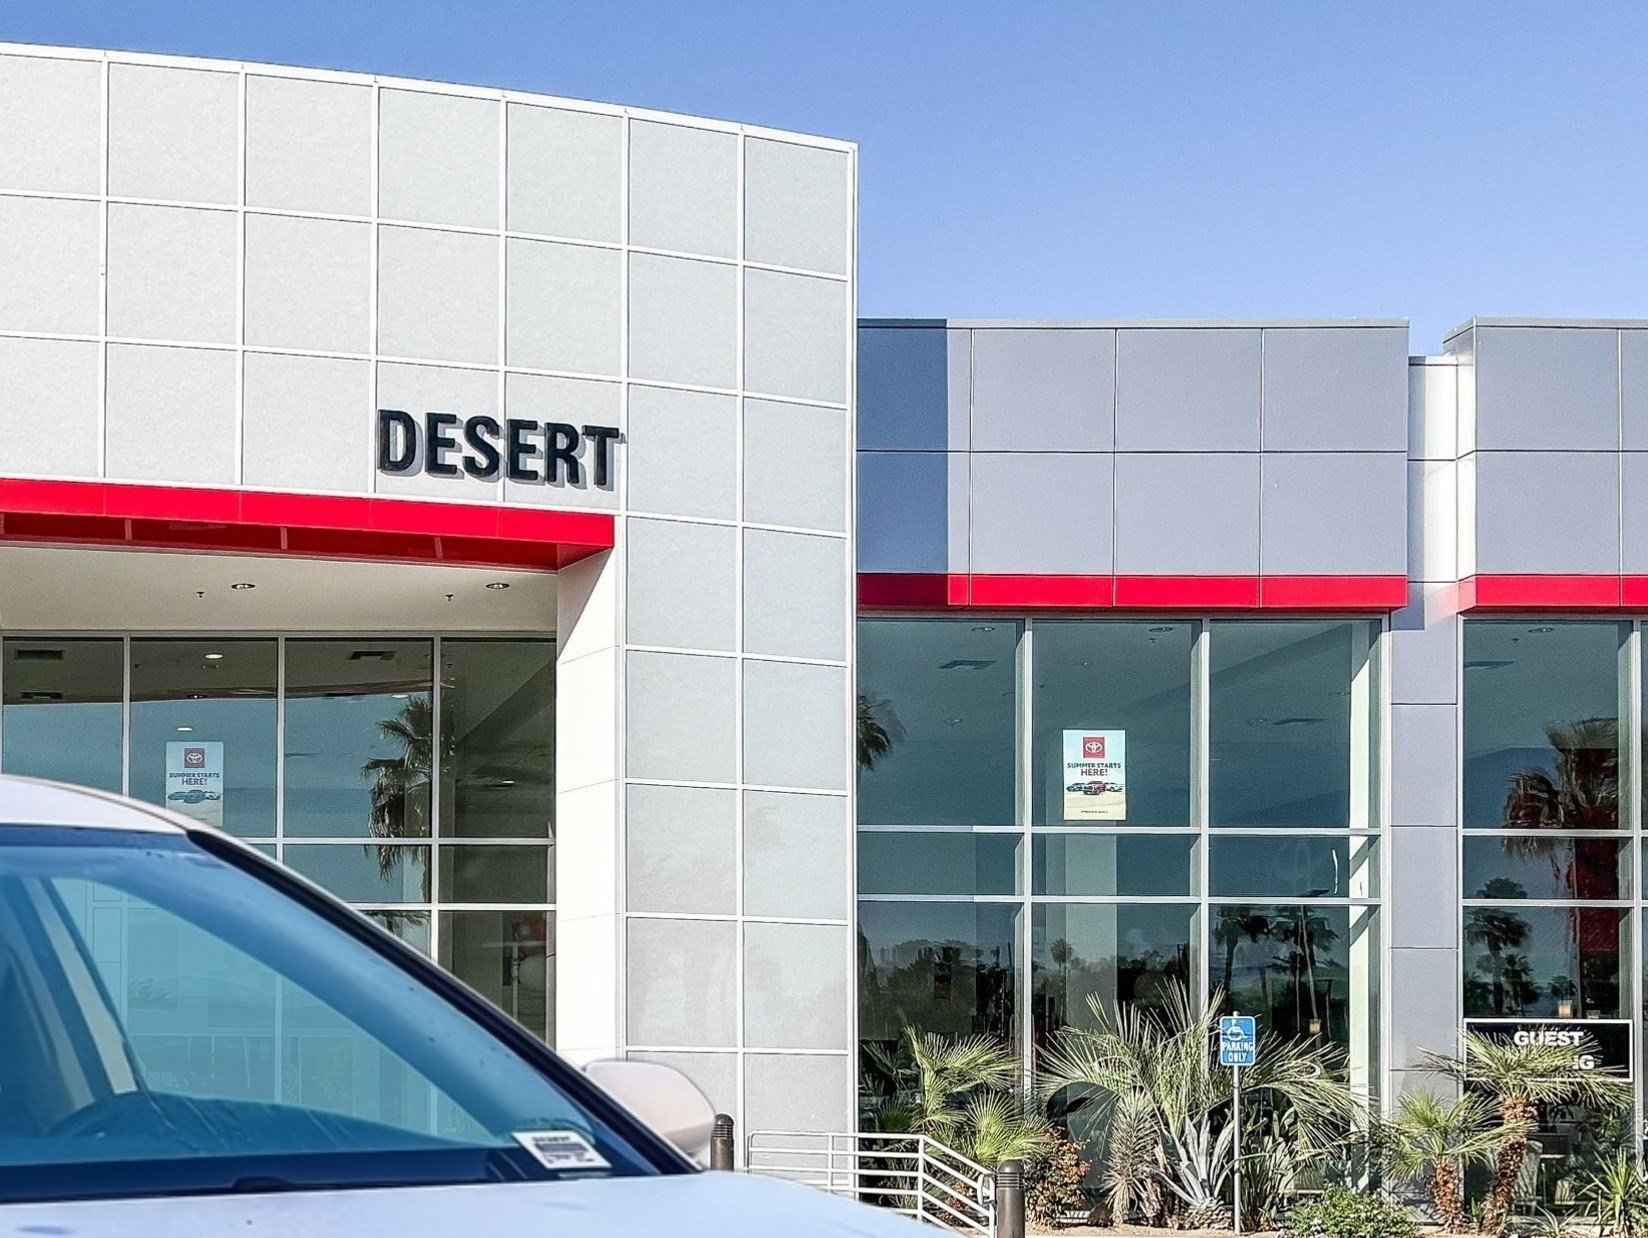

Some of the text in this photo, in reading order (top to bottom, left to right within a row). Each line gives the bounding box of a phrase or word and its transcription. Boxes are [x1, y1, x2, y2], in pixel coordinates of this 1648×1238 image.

[377, 409, 620, 486] DESERT
[1513, 1030, 1584, 1047] GUEST
[1222, 1041, 1254, 1051] PARKING
[1228, 1051, 1248, 1062] ONLY
